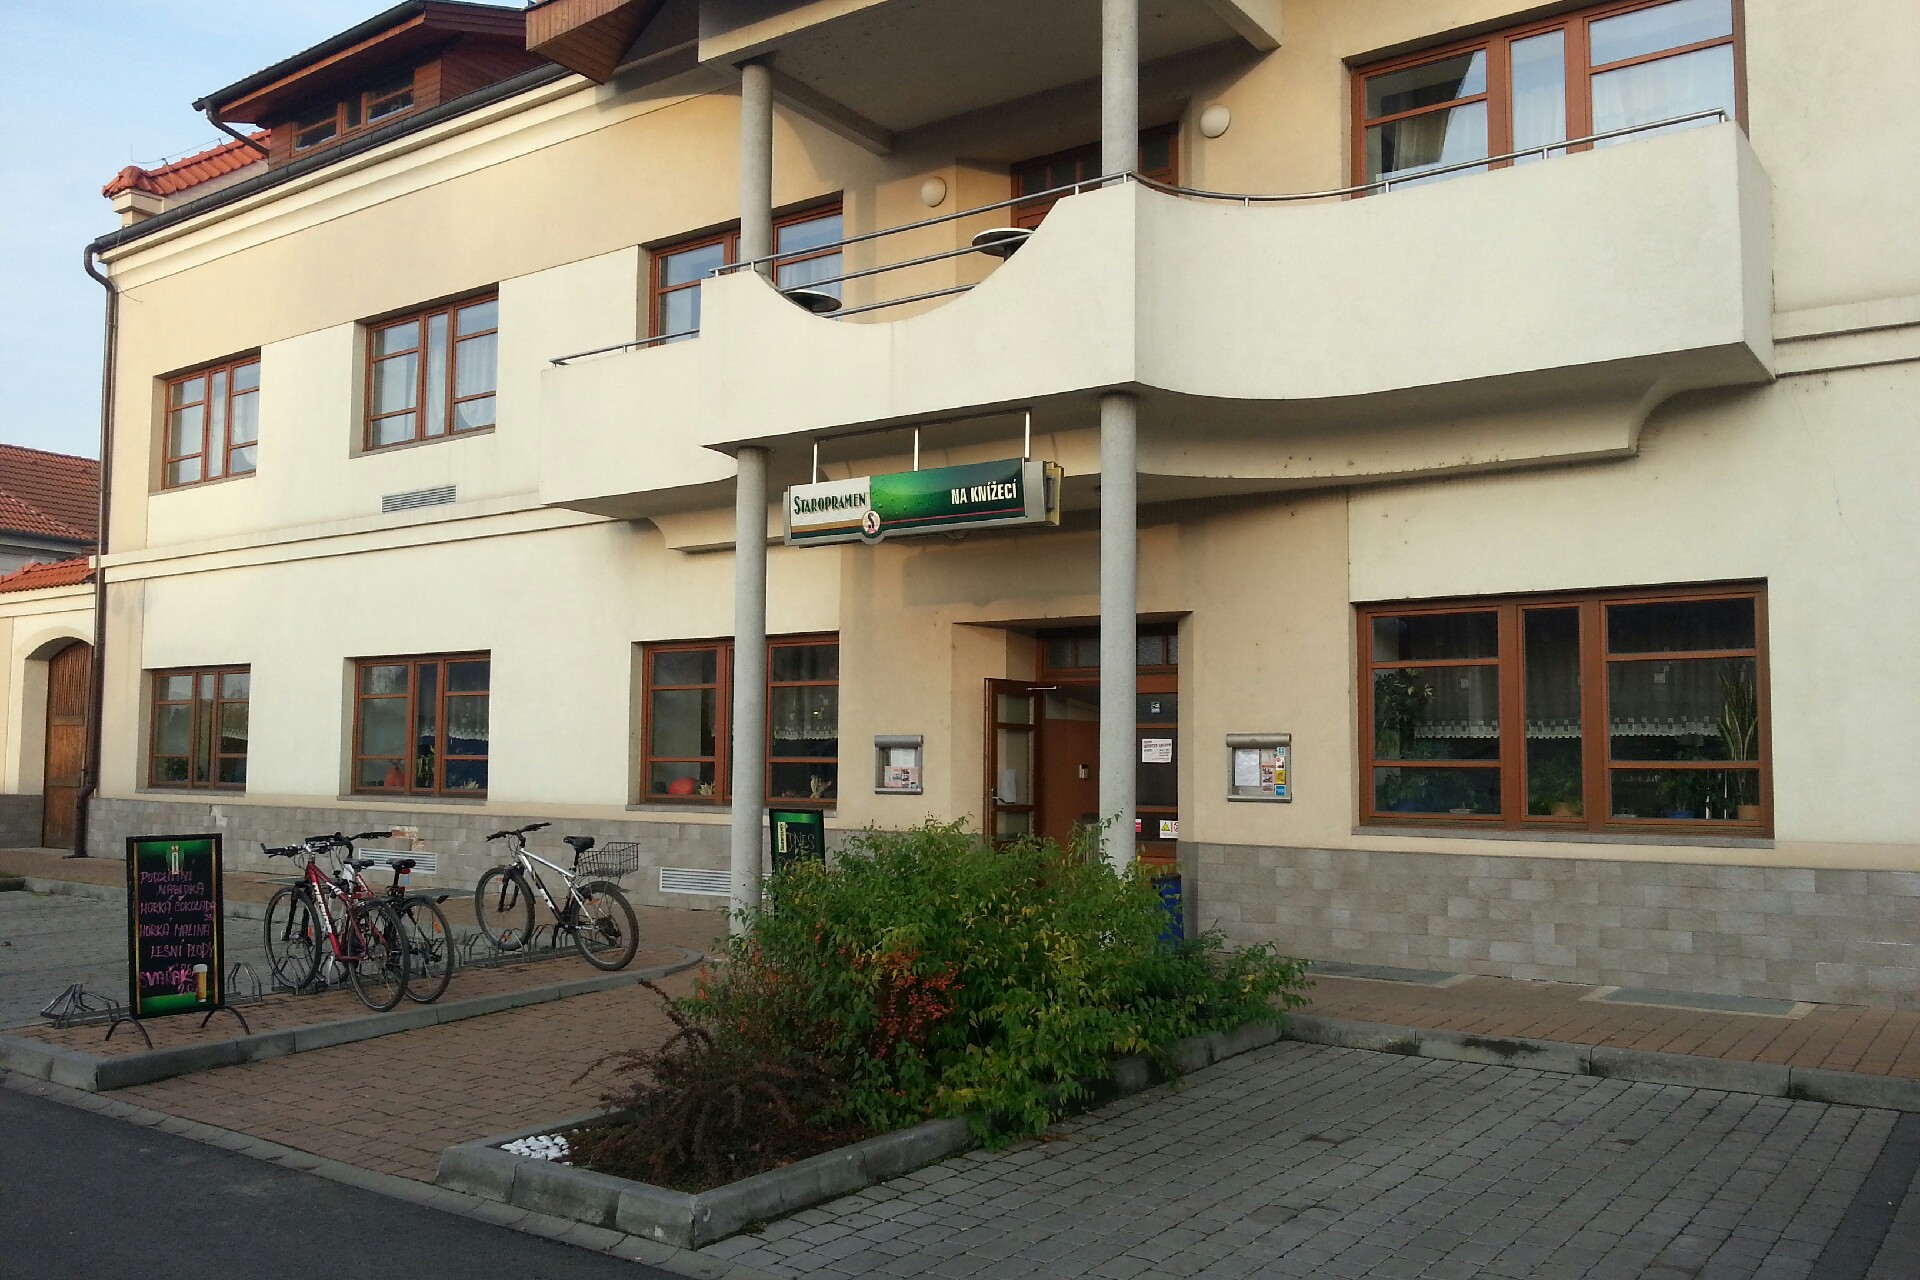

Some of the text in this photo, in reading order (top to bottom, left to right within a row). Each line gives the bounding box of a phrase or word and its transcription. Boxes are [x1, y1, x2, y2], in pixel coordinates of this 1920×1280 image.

[951, 479, 1017, 505] NA KNÍŽECÍ
[794, 492, 866, 515] STAROPRAMEN
[174, 923, 210, 937] MALINA
[151, 939, 185, 958] LESNÍ
